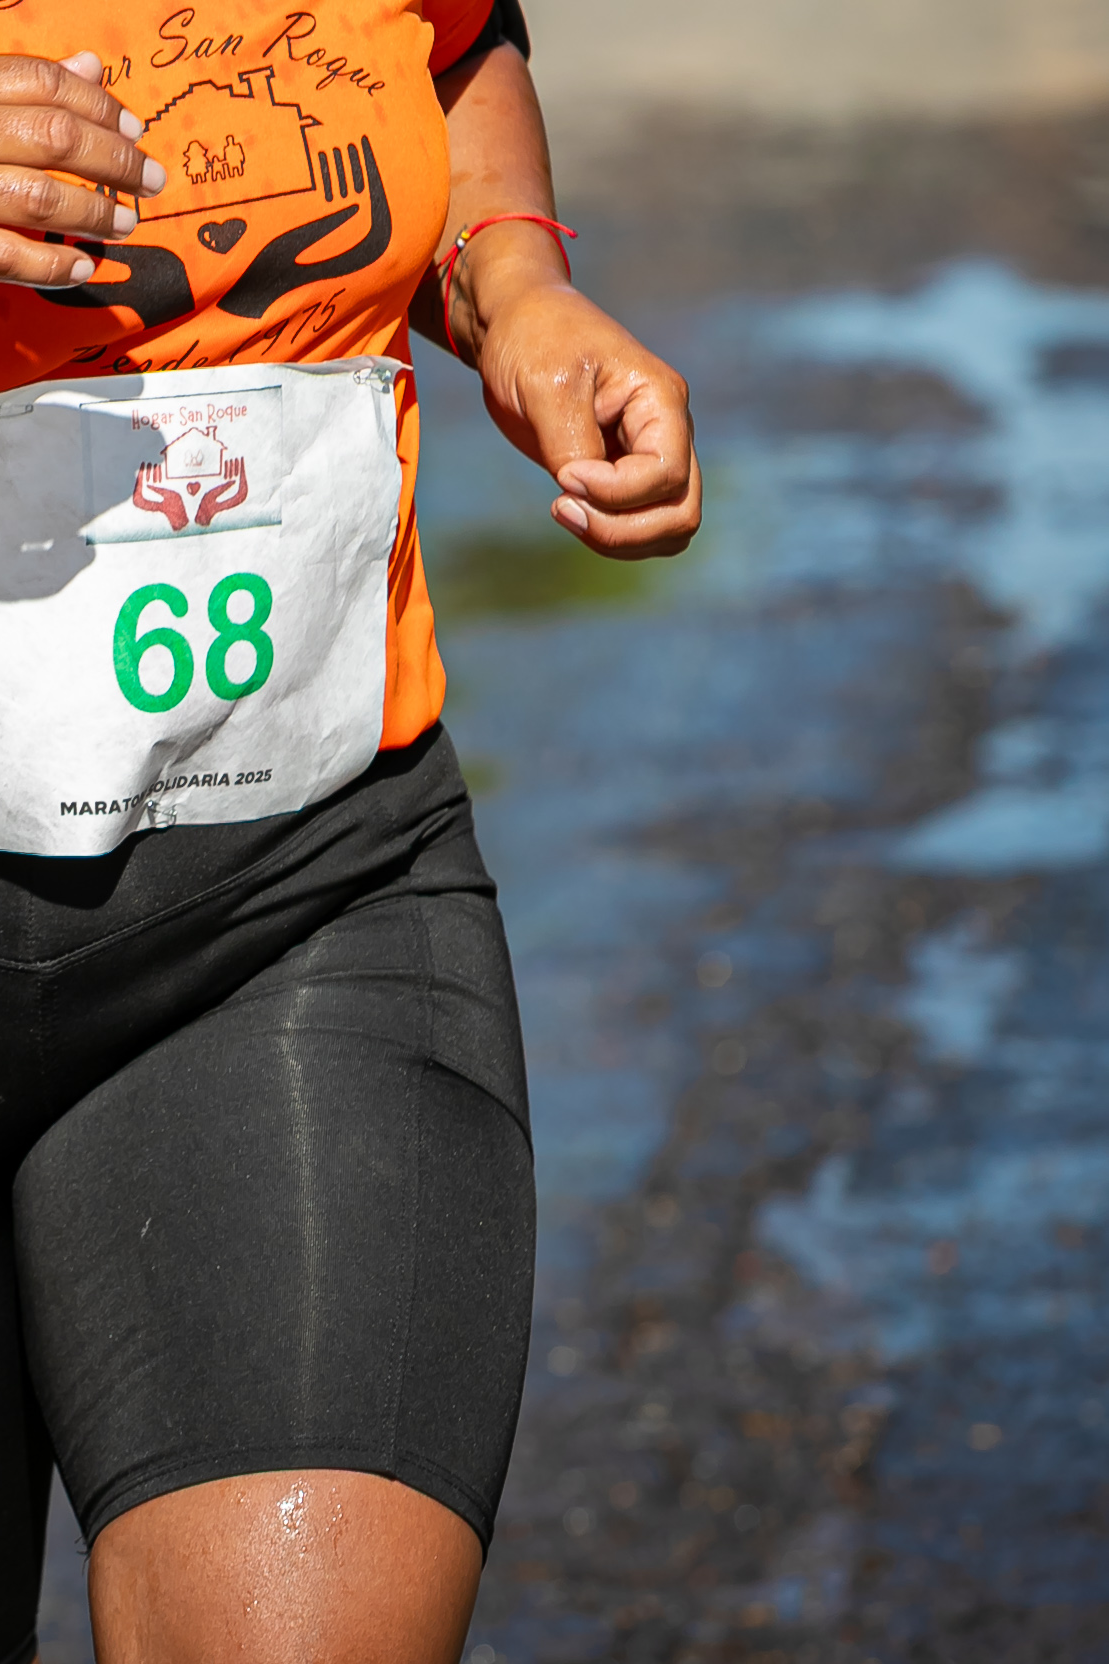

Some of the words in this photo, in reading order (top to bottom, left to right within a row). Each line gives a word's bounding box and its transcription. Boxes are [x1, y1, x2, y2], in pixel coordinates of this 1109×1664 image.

[150, 7, 244, 69] San
[262, 11, 387, 97] Roque
[228, 287, 347, 364] 1975
[131, 408, 175, 431] Hogar
[179, 406, 204, 427] San
[206, 403, 248, 425] Roque
[112, 571, 275, 714] 68
[234, 768, 274, 786] 2025
